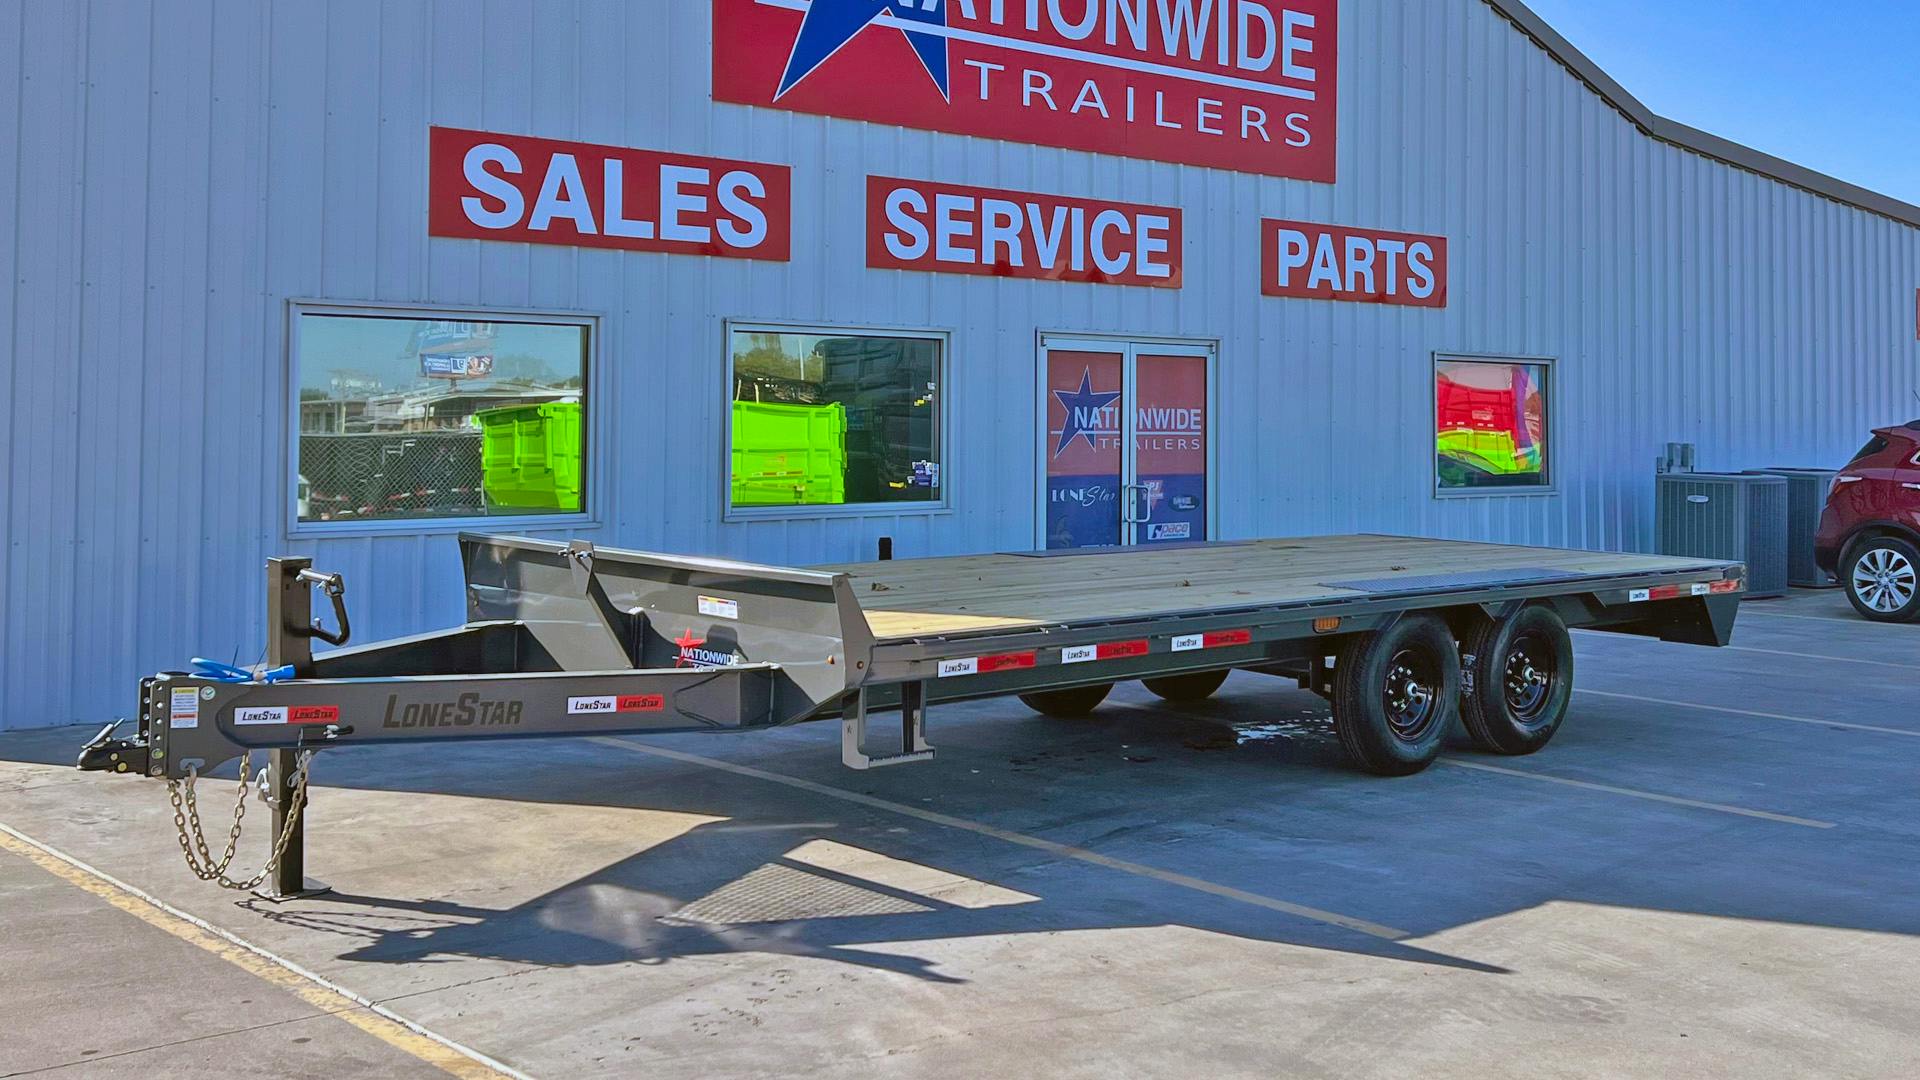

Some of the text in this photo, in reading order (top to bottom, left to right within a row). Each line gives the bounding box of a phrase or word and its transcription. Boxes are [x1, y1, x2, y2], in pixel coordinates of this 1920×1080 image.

[880, 0, 1316, 82] NWIDE
[963, 58, 1312, 148] TRAILERS
[460, 143, 768, 248] SALES
[883, 187, 1170, 278] SERVICE
[1277, 228, 1434, 298] PARTS
[1074, 406, 1202, 430] NATINWIDE
[680, 646, 739, 666] NATIONWIDE
